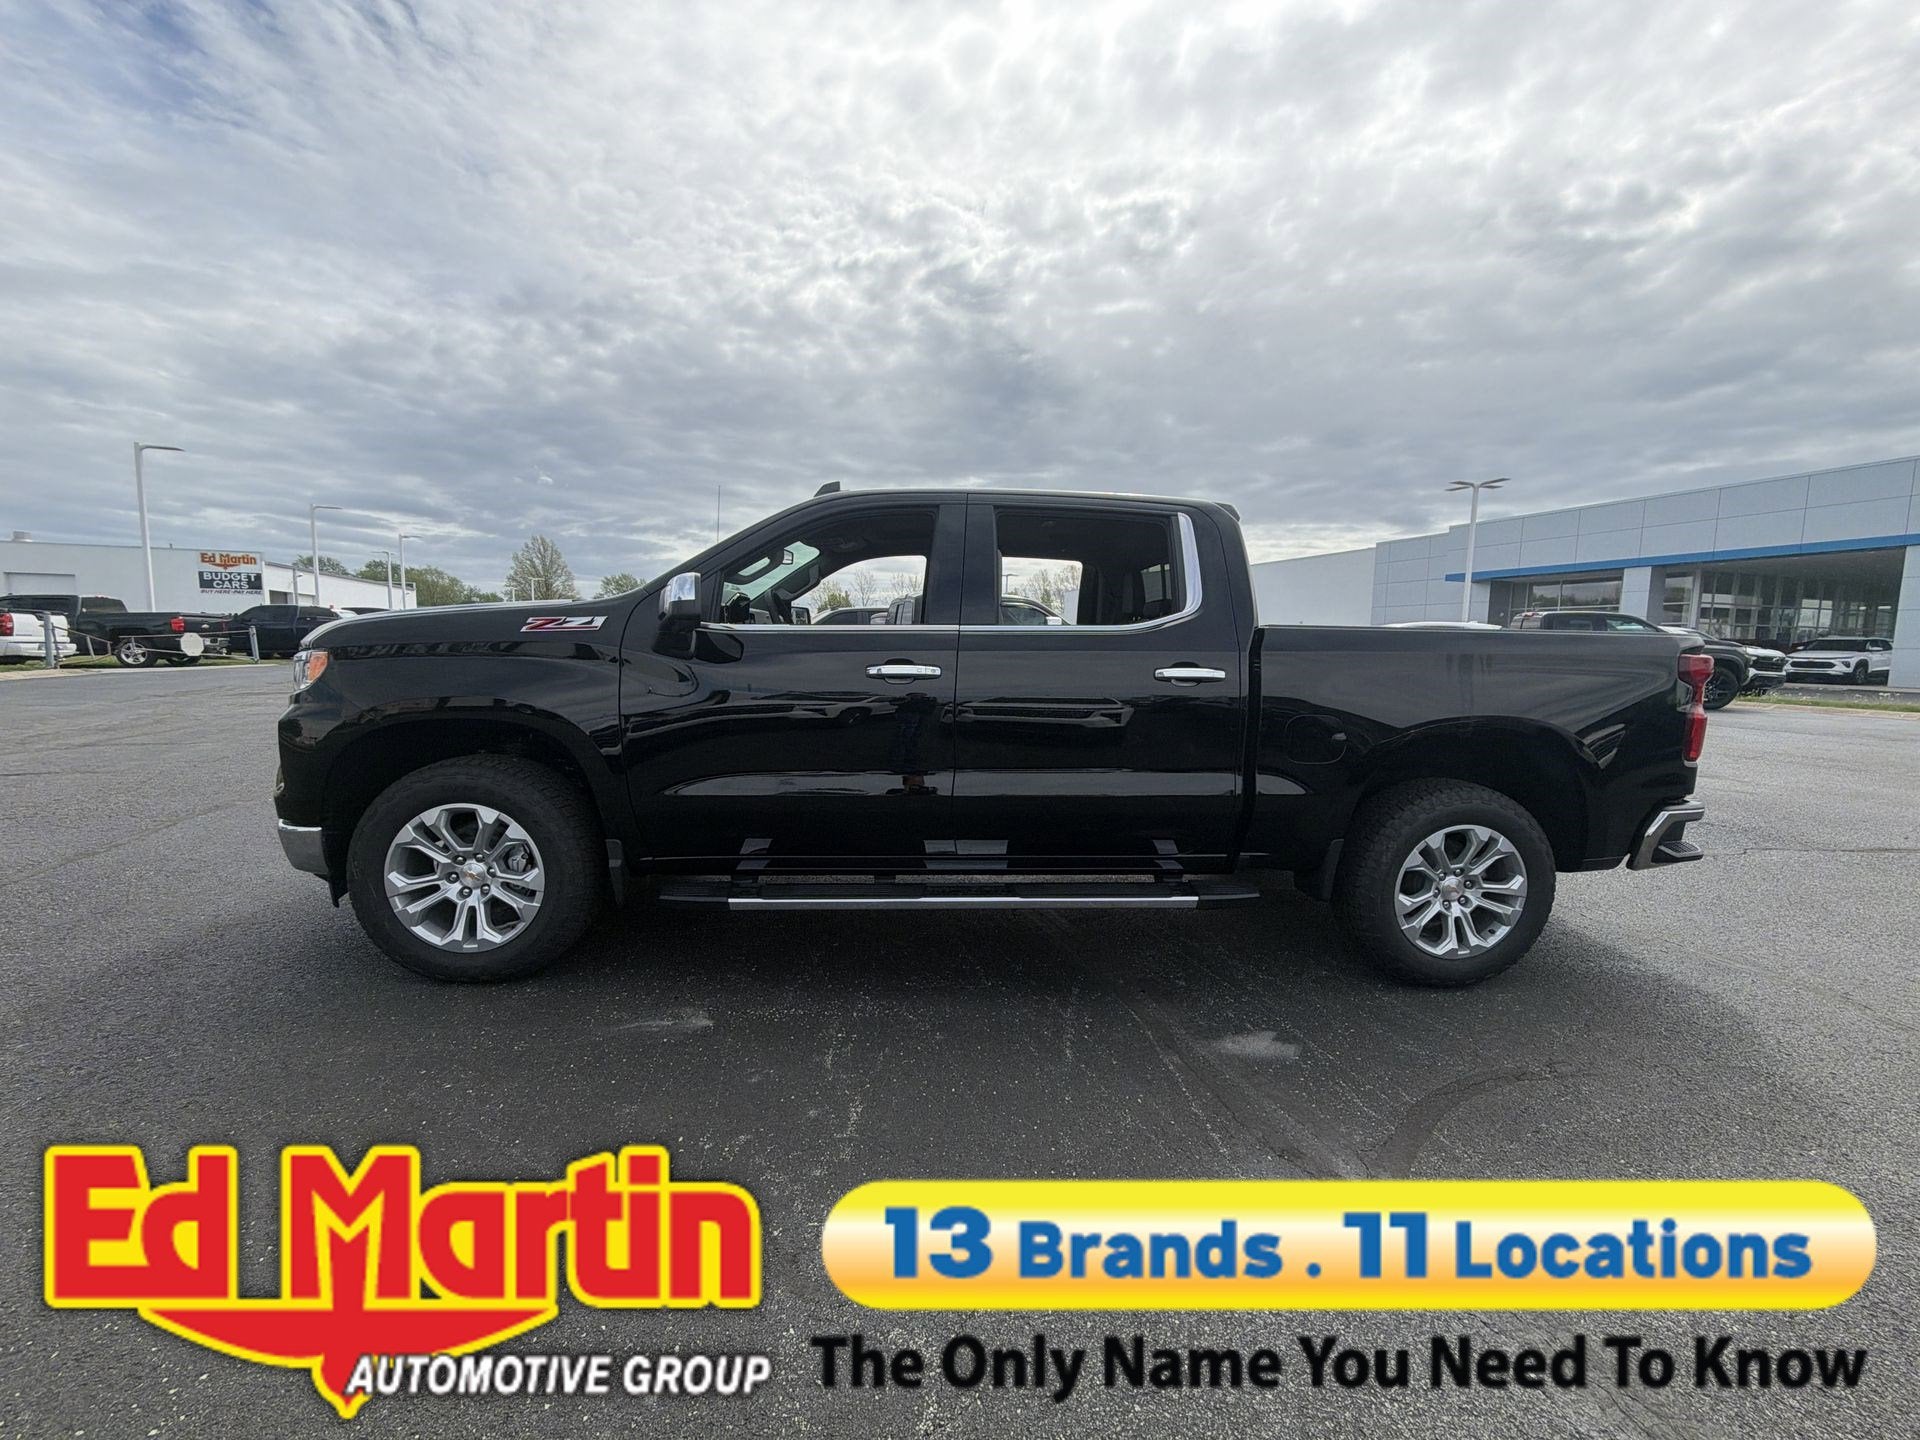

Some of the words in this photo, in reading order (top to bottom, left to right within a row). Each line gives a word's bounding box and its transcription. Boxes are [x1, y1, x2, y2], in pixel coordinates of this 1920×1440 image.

[200, 552, 216, 563] Ed
[219, 553, 257, 566] Martin
[203, 572, 257, 581] BUDGET
[213, 580, 249, 589] CARS
[520, 616, 608, 632] Z71
